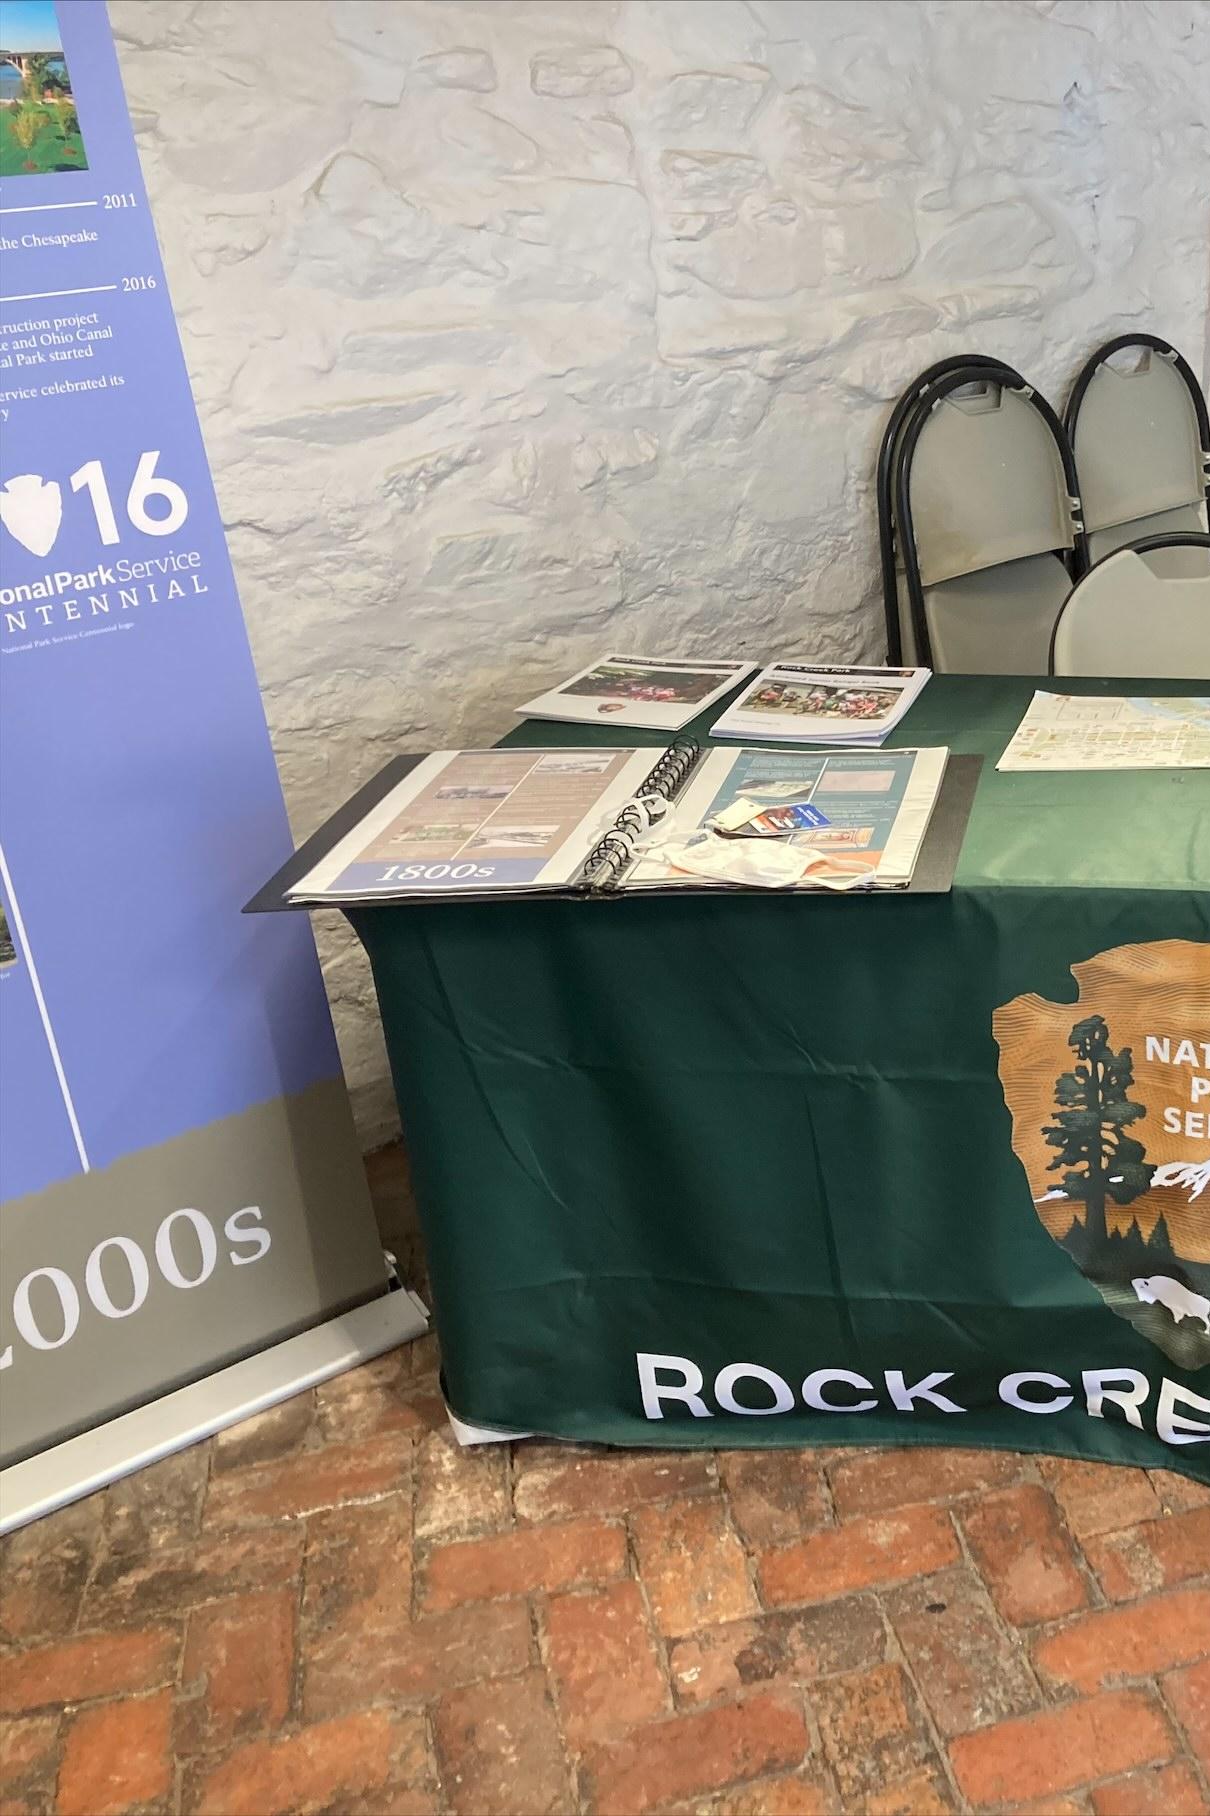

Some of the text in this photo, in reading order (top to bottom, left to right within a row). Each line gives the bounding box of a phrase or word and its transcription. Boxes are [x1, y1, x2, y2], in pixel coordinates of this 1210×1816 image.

[103, 193, 137, 209] 2011
[21, 229, 99, 248] Chesapeake
[121, 276, 157, 292] 2016
[53, 312, 99, 331] project
[12, 335, 37, 350] and
[40, 331, 74, 346] Ohio
[76, 325, 113, 341] Canal
[16, 352, 46, 366] Park
[49, 344, 94, 362] started
[40, 375, 107, 396] celebrated
[110, 375, 125, 386] its
[69, 450, 189, 546] 16
[375, 863, 496, 883] 1800s
[0, 1206, 271, 1370] 000s
[636, 1352, 968, 1420] ROCK
